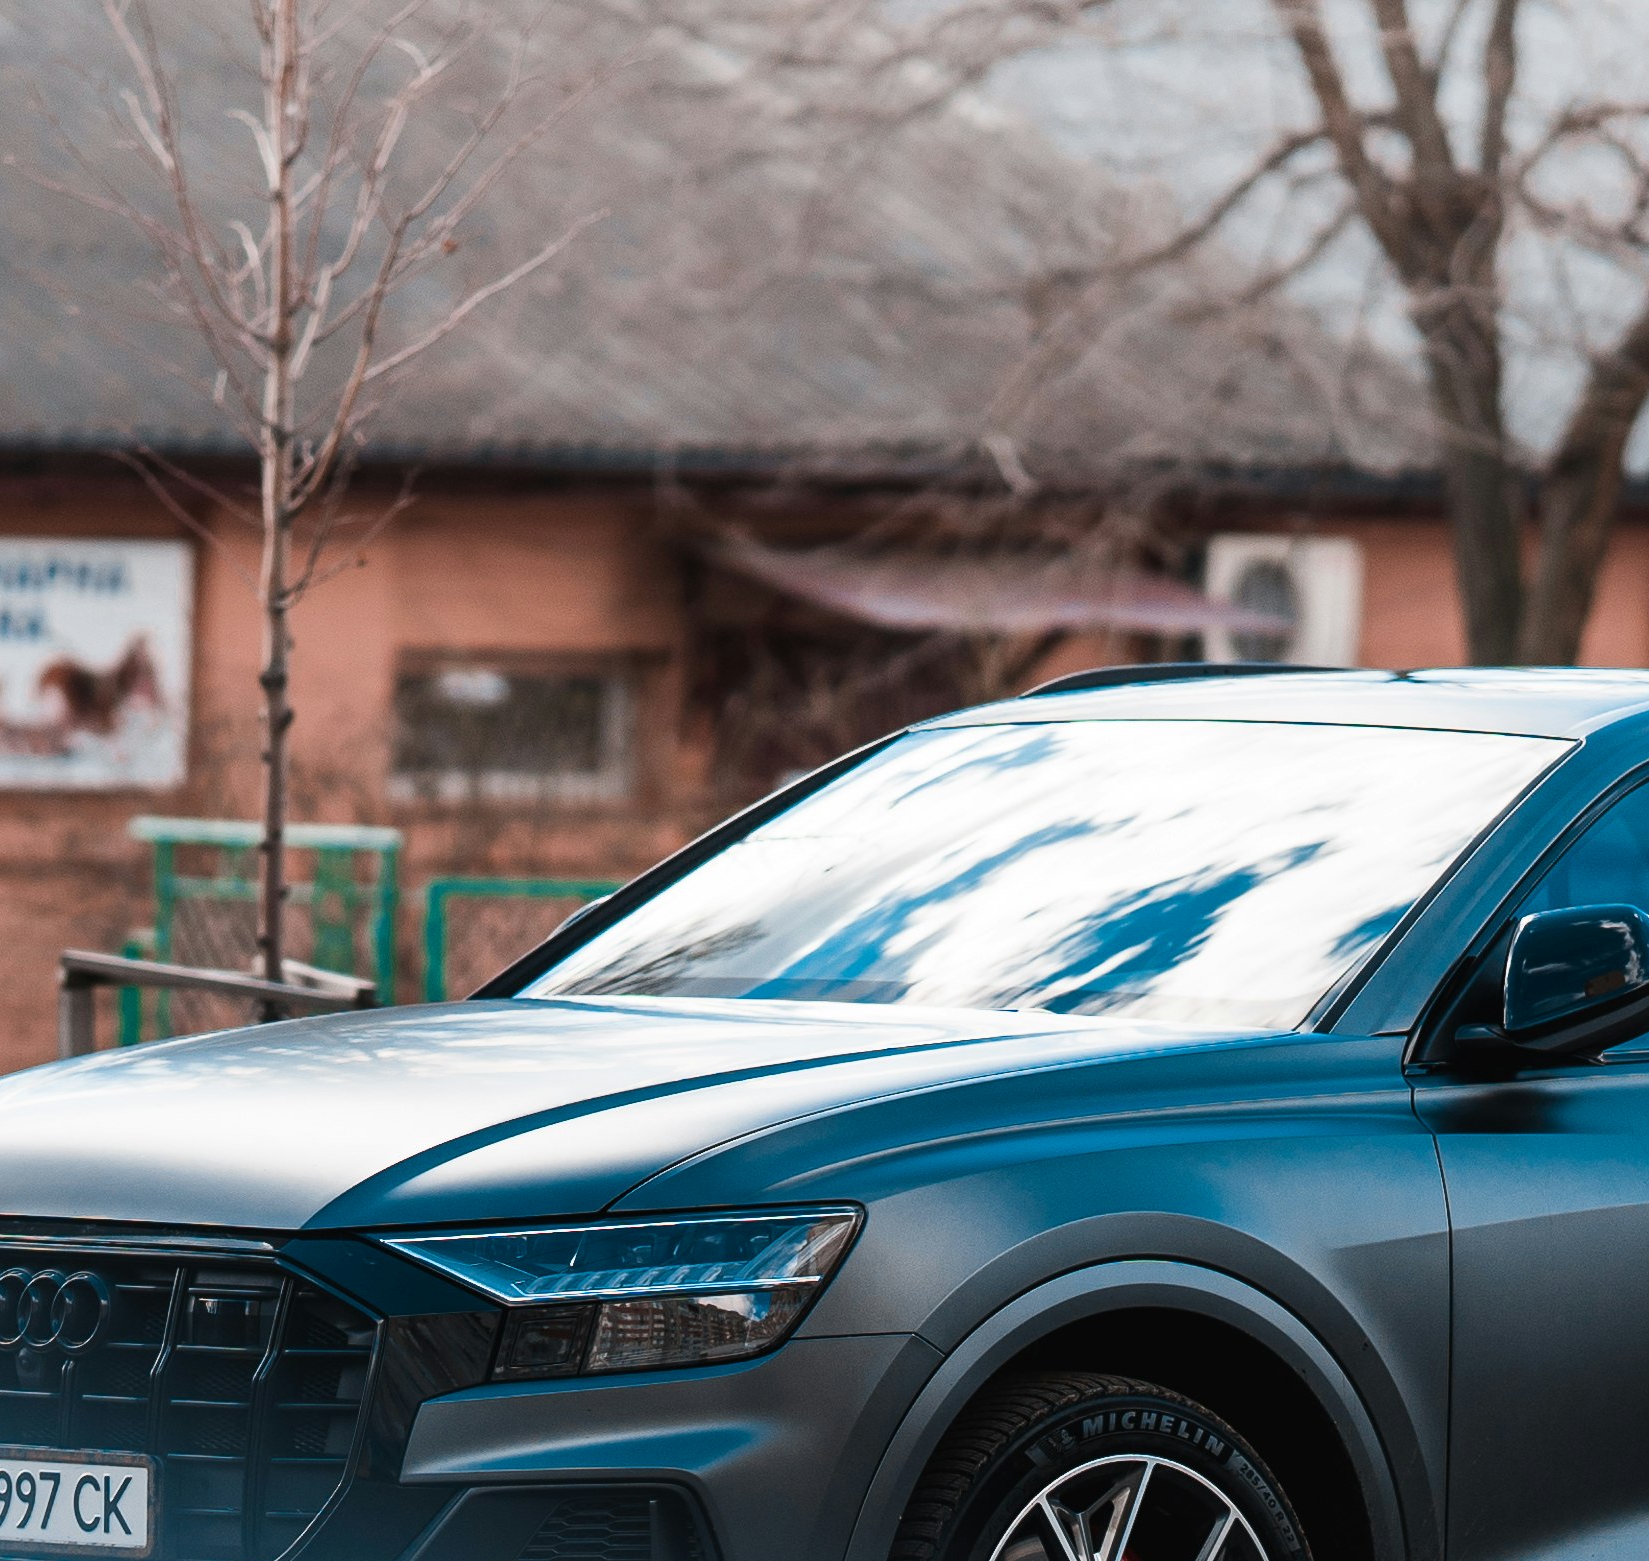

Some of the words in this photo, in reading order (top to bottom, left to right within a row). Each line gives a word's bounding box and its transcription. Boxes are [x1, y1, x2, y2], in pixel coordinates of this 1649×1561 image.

[1082, 1409, 1226, 1459] MICHELIN
[73, 1472, 133, 1536] CK
[1239, 1462, 1277, 1510] 285/40
